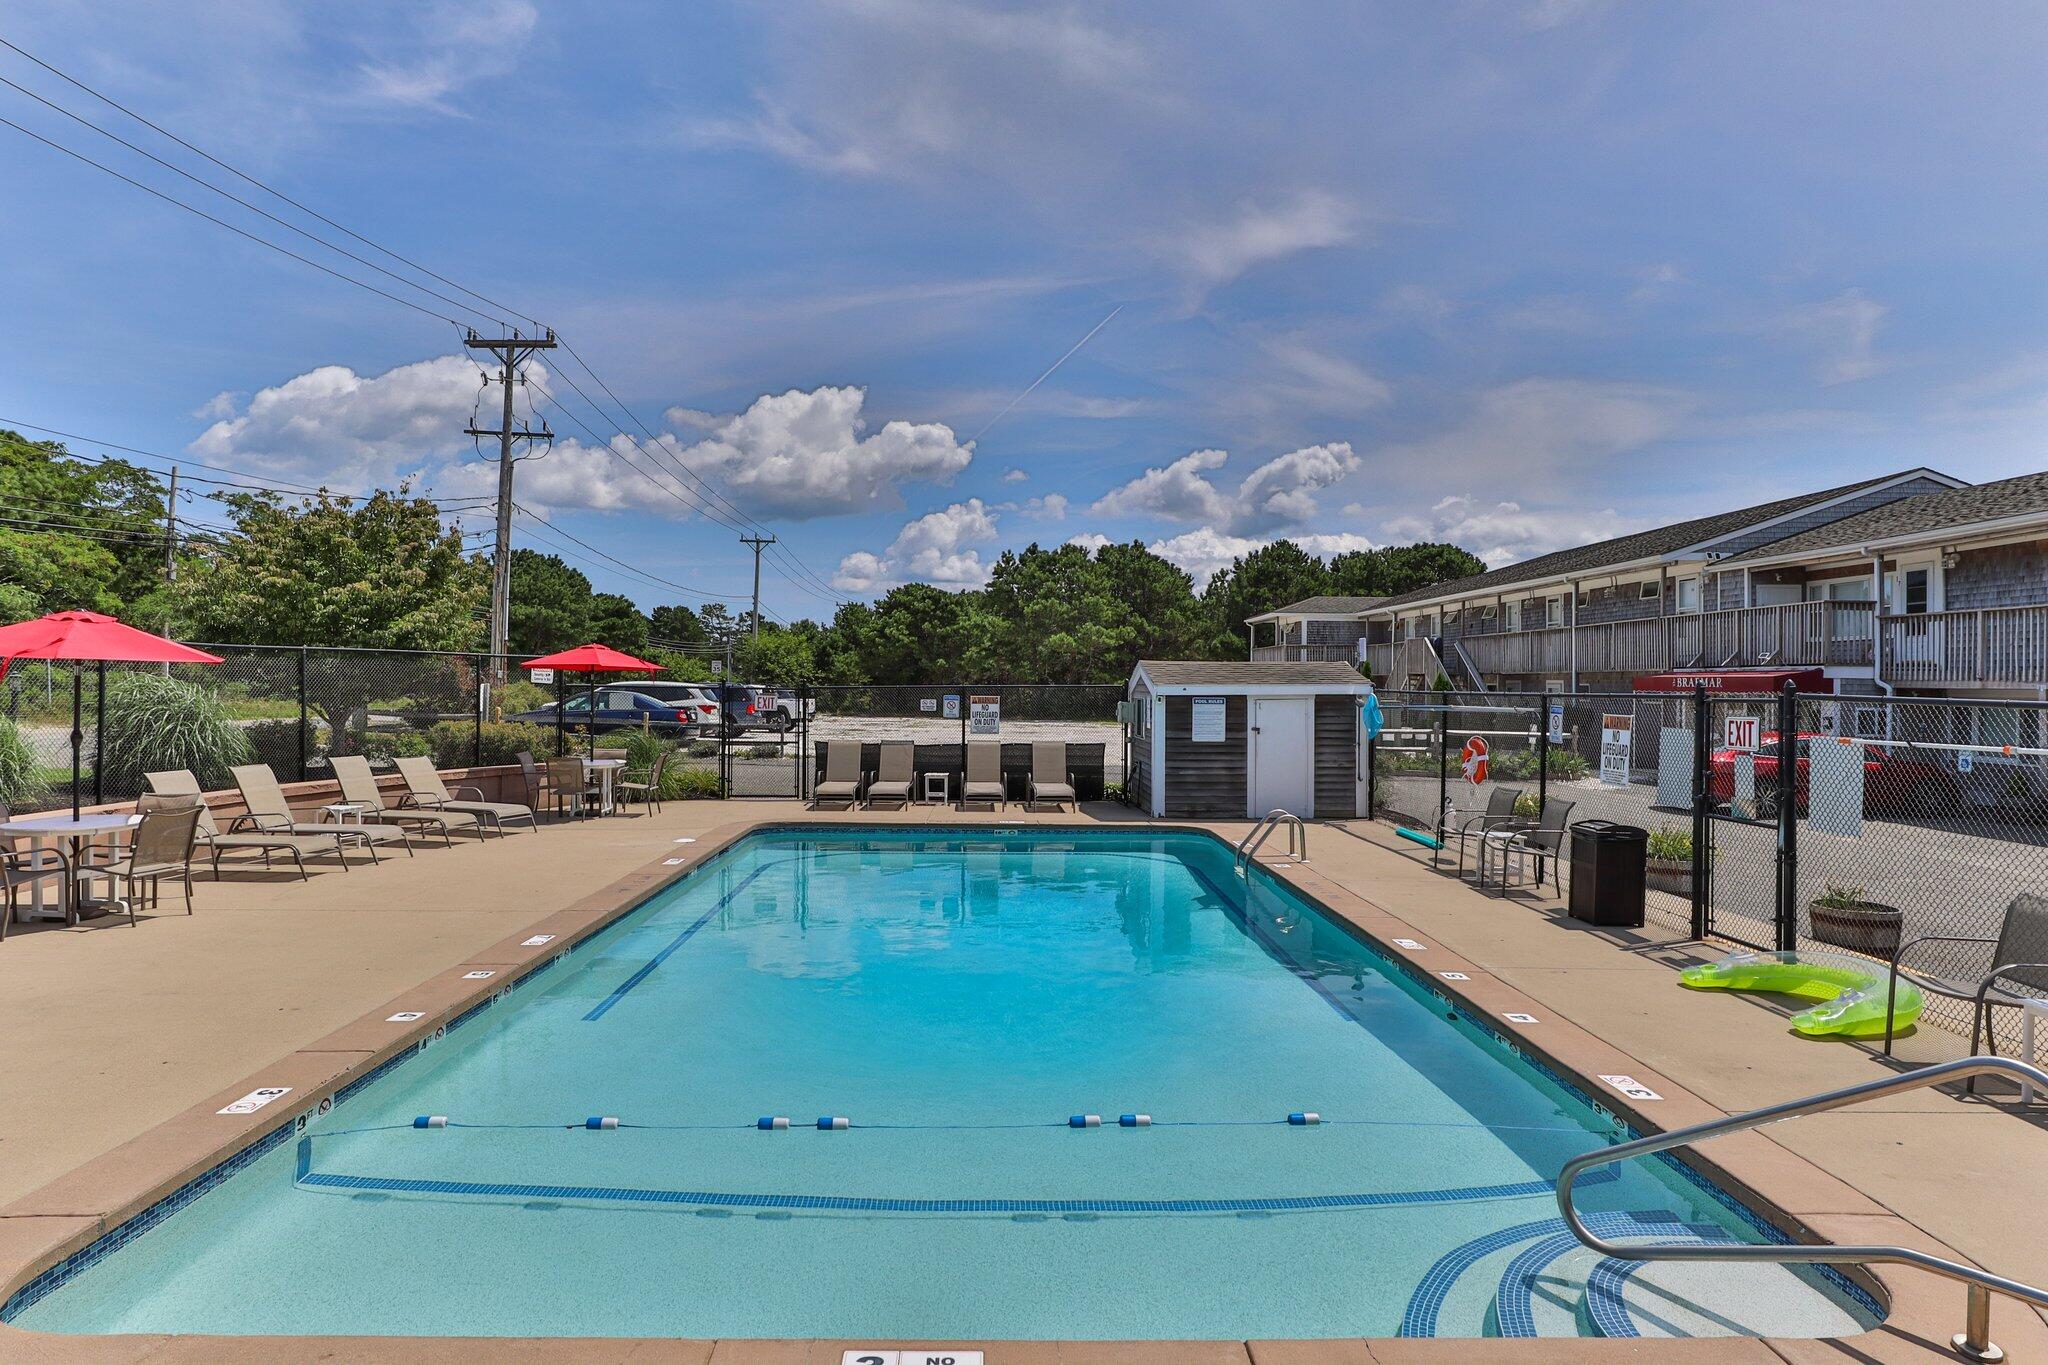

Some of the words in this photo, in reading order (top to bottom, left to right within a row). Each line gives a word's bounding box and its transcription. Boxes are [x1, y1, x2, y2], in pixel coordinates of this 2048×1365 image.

[757, 696, 775, 710] EXIT
[980, 704, 990, 712] NO
[971, 711, 999, 719] LIFEGUARD
[1612, 730, 1621, 743] NO
[1728, 720, 1755, 748] EXIT
[1602, 742, 1629, 758] LIFEGUARD
[1604, 756, 1612, 770] ON
[1613, 757, 1626, 771] DUTY
[1626, 1089, 1652, 1097] 3
[926, 1357, 956, 1365] NO
